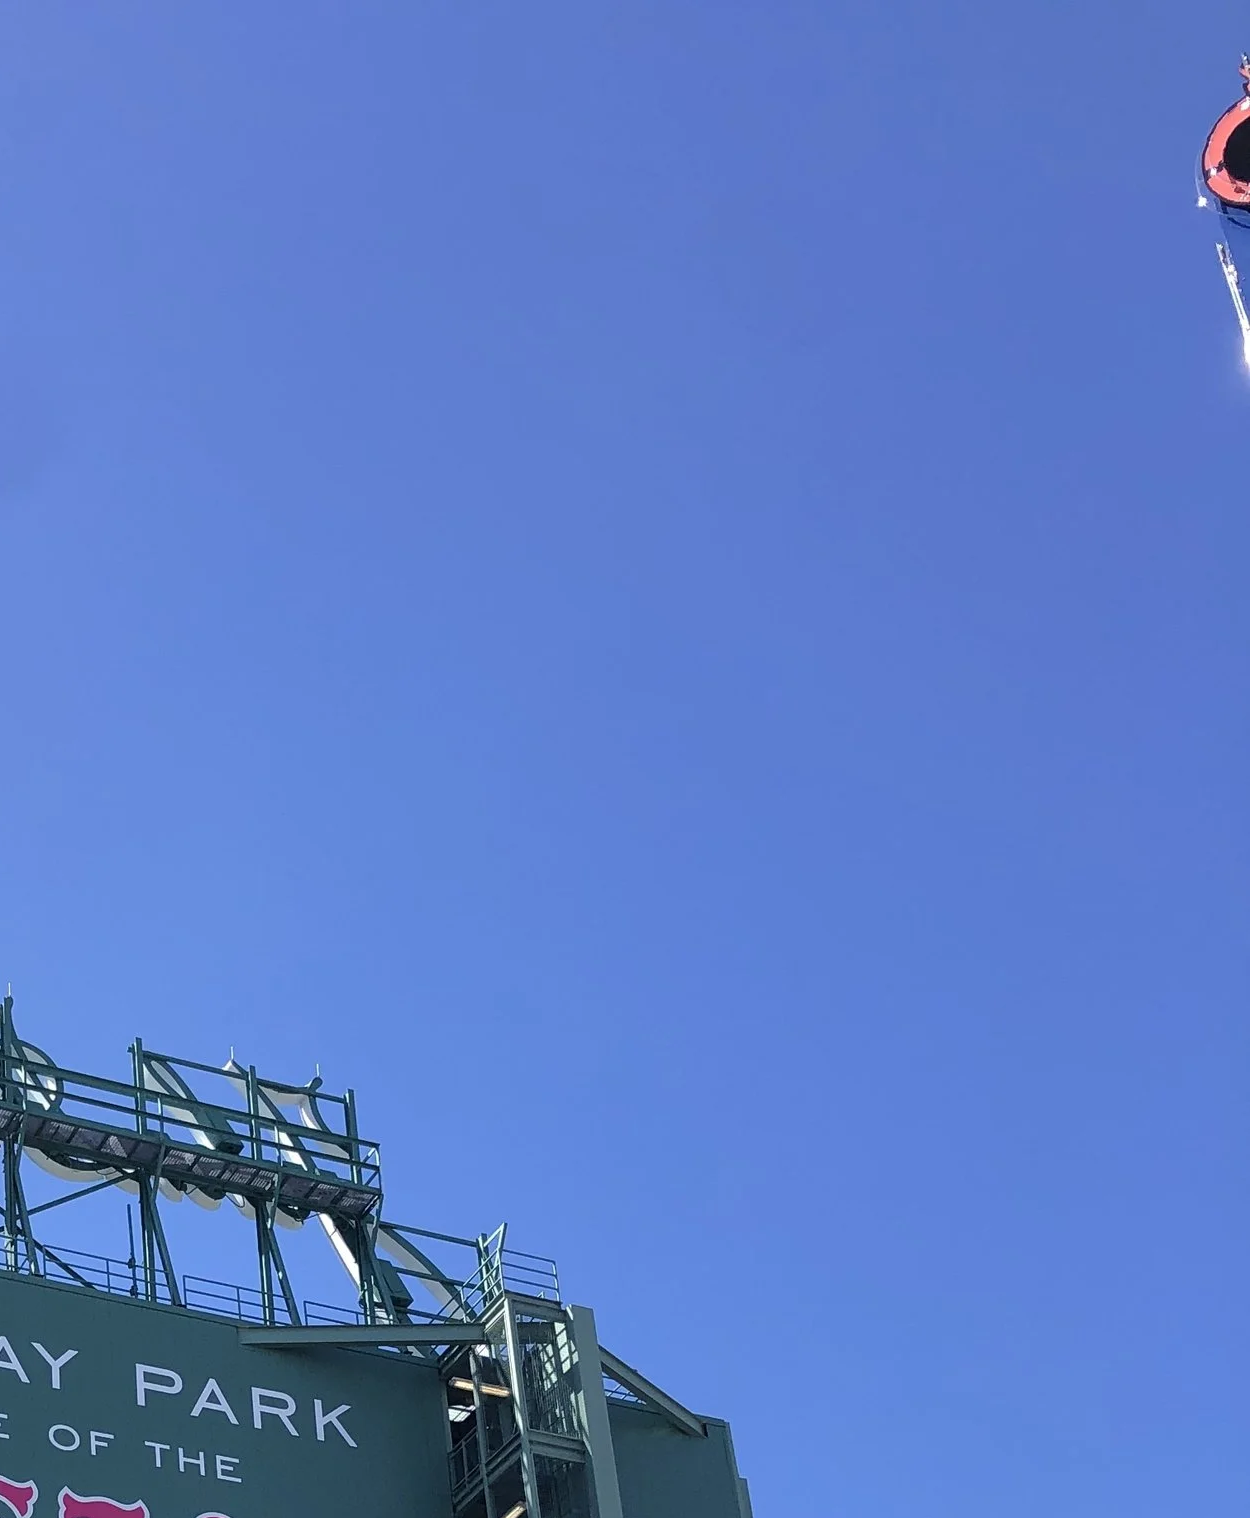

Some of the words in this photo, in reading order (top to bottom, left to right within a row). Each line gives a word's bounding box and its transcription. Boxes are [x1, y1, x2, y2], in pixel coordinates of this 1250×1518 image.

[135, 1362, 358, 1448] PARK
[48, 1424, 115, 1456] OF
[145, 1440, 243, 1483] THE
